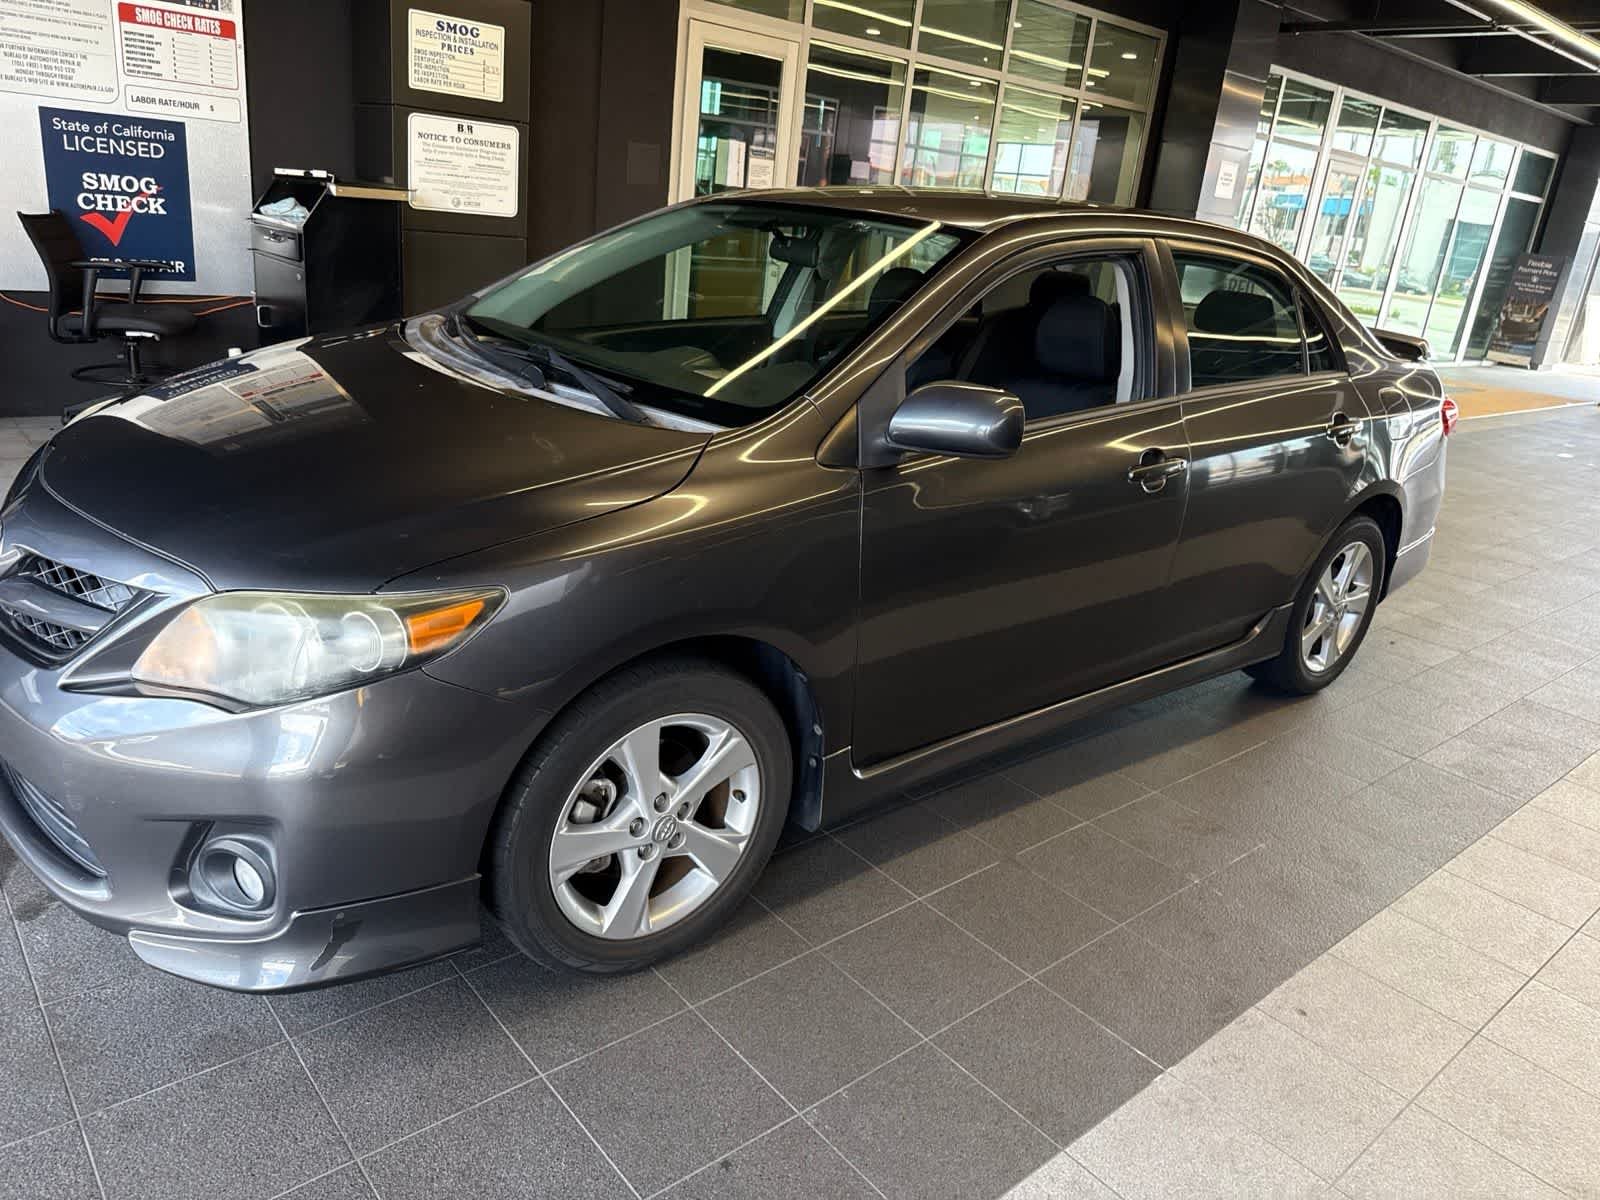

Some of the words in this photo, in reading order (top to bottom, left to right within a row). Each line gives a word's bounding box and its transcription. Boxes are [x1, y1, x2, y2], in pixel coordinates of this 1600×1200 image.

[135, 7, 163, 26] SMOG
[164, 12, 193, 31] CHECK
[195, 17, 221, 35] RATES
[436, 20, 481, 38] SMOG
[415, 29, 451, 42] INSPECTION
[458, 37, 499, 50] INSTALLATION
[441, 43, 475, 55] PRICES
[130, 95, 157, 105] LABOR
[158, 98, 200, 110] RATE/HOUR
[52, 117, 90, 132] State
[94, 122, 108, 134] of
[112, 124, 175, 142] California
[63, 134, 165, 159] LICENSED
[417, 131, 448, 142] NOTICE
[449, 135, 462, 144] TO
[463, 138, 512, 150] CONSUMERS
[82, 172, 158, 195] SMOG
[77, 193, 167, 215] CHECK
